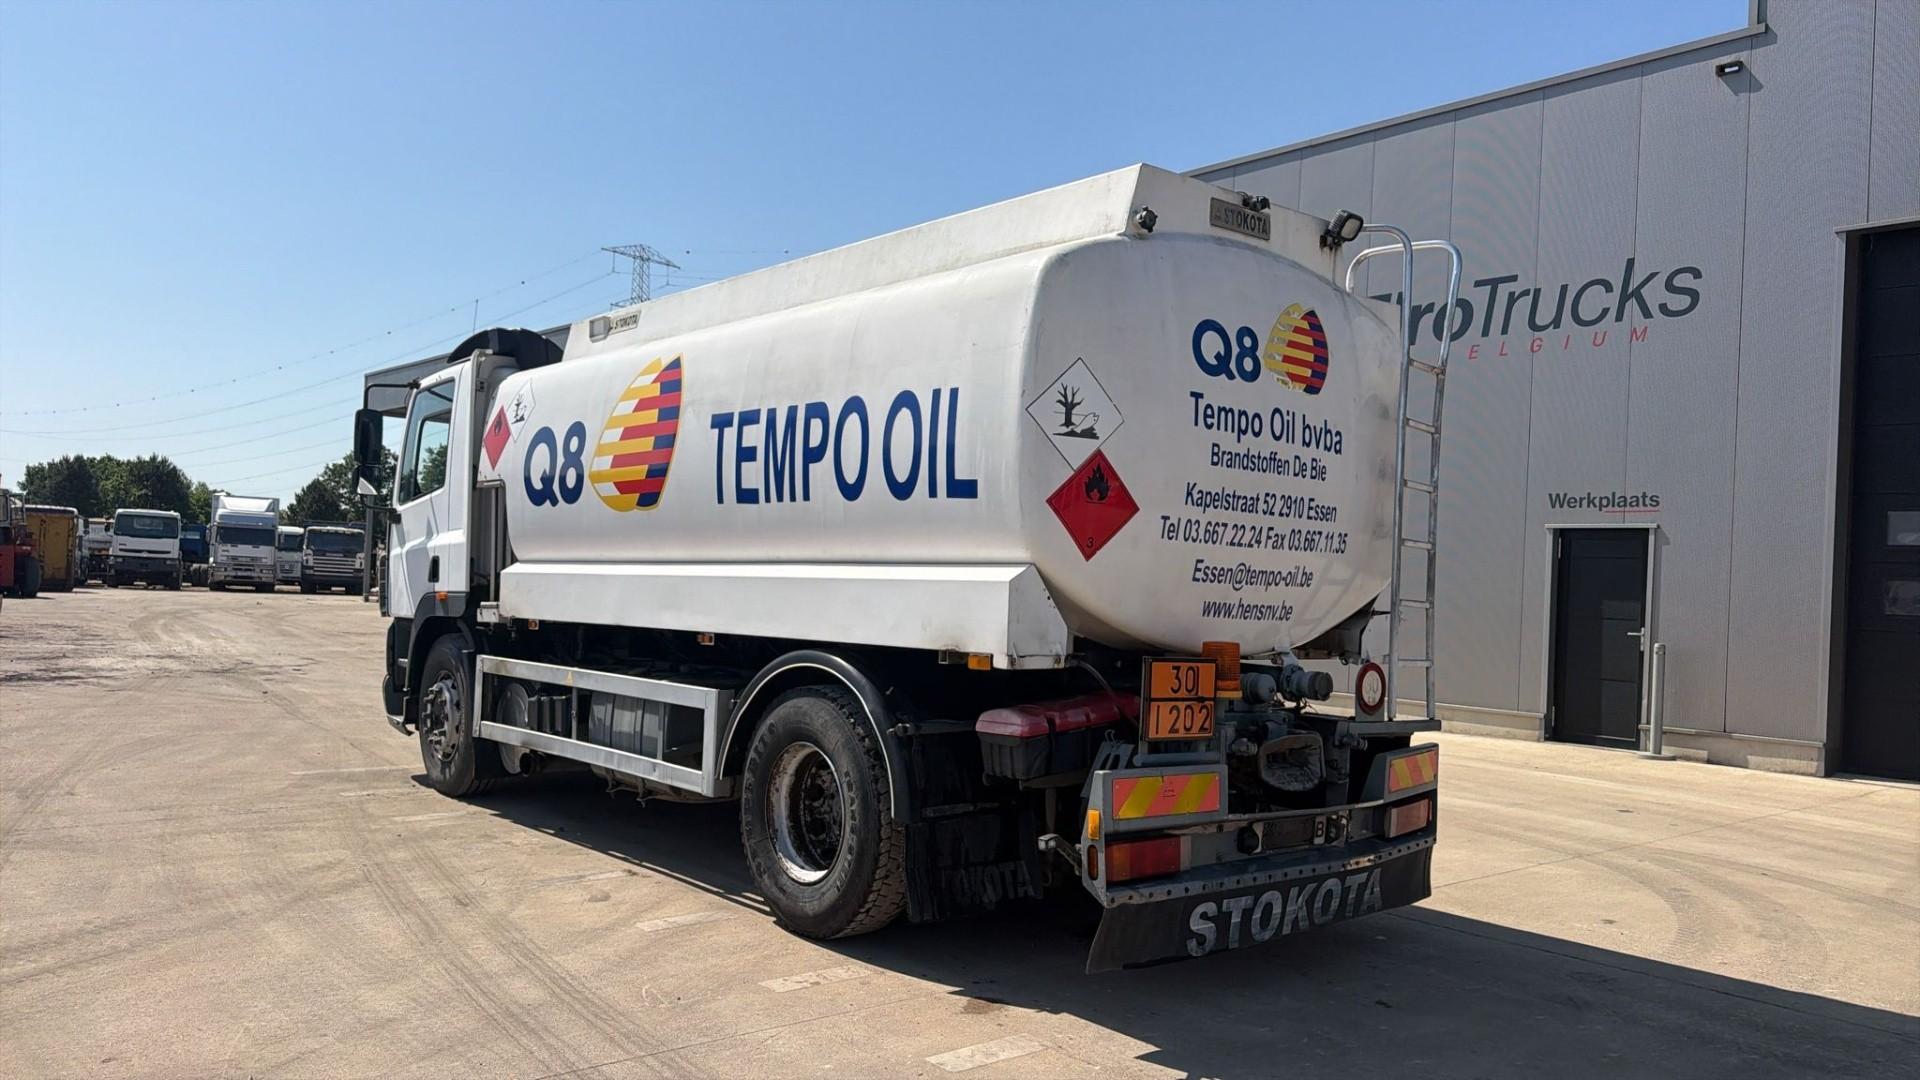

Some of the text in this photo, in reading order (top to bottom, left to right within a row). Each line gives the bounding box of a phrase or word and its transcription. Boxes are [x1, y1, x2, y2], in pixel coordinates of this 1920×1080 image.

[1223, 206, 1268, 236] STOKOTA
[1368, 257, 1703, 347] roTrucks
[1191, 318, 1262, 383] Q8
[1467, 326, 1649, 360] ELGIUM
[1189, 390, 1343, 455] Tempo Oil bvba
[523, 420, 587, 508] Q8
[710, 386, 979, 505] TEMPO OIL
[1210, 442, 1327, 482] Brandstoffen De Bie
[1184, 481, 1338, 524] Kapelstraat 52 2910 Essen
[1548, 491, 1661, 512] Werkplaats
[1086, 536, 1095, 549] 3
[1160, 515, 1349, 555] Tel 03.667.22.24 Fax 03.667.11.35
[1191, 558, 1314, 592] Essen@tempo-oil.be
[1201, 597, 1294, 622] www.hensnv.be
[1170, 665, 1196, 695] 30
[1155, 703, 1211, 735] 1202
[1186, 866, 1384, 958] STOKOTA
